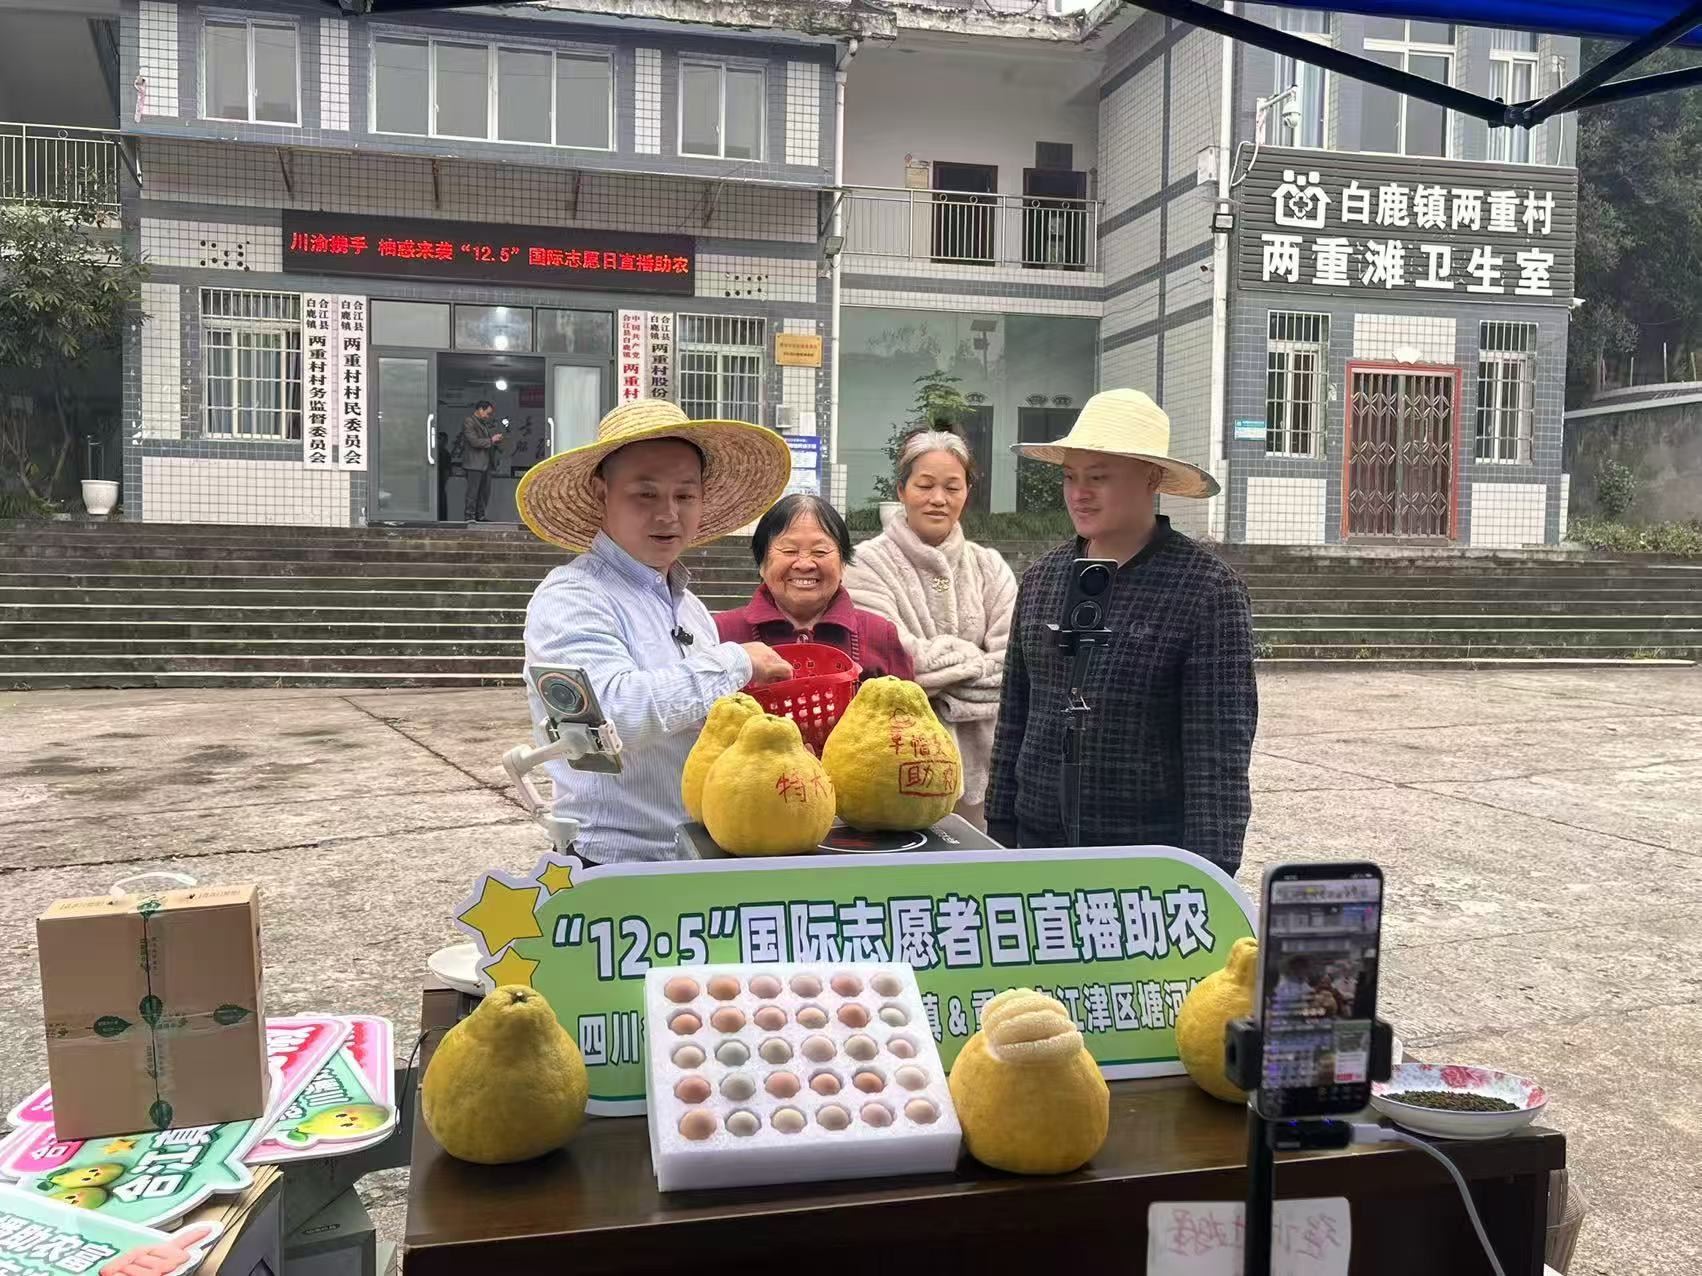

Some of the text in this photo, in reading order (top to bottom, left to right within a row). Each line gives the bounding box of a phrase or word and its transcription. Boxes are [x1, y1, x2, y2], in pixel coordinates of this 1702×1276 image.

[1341, 180, 1556, 236] 白鹿镇两重村
[290, 232, 369, 255] 川渝携手
[528, 247, 690, 274] 国际志愿日直播助农
[1261, 233, 1555, 296] 两重滩卫生室
[306, 298, 317, 330] 白鹿镇
[319, 299, 329, 330] 合江县
[341, 299, 352, 331] 白鹿镇
[353, 300, 364, 332] 合江县
[650, 315, 660, 340] 白鹿镇
[661, 315, 671, 341] 合江县
[632, 315, 640, 359] 中国共产党
[623, 363, 640, 403] 两重村
[651, 343, 670, 401] 两重村股份
[308, 335, 328, 464] 两重村村务监督委员会
[343, 337, 363, 465] 两重村村民委员会
[577, 1009, 645, 1067] 四川
